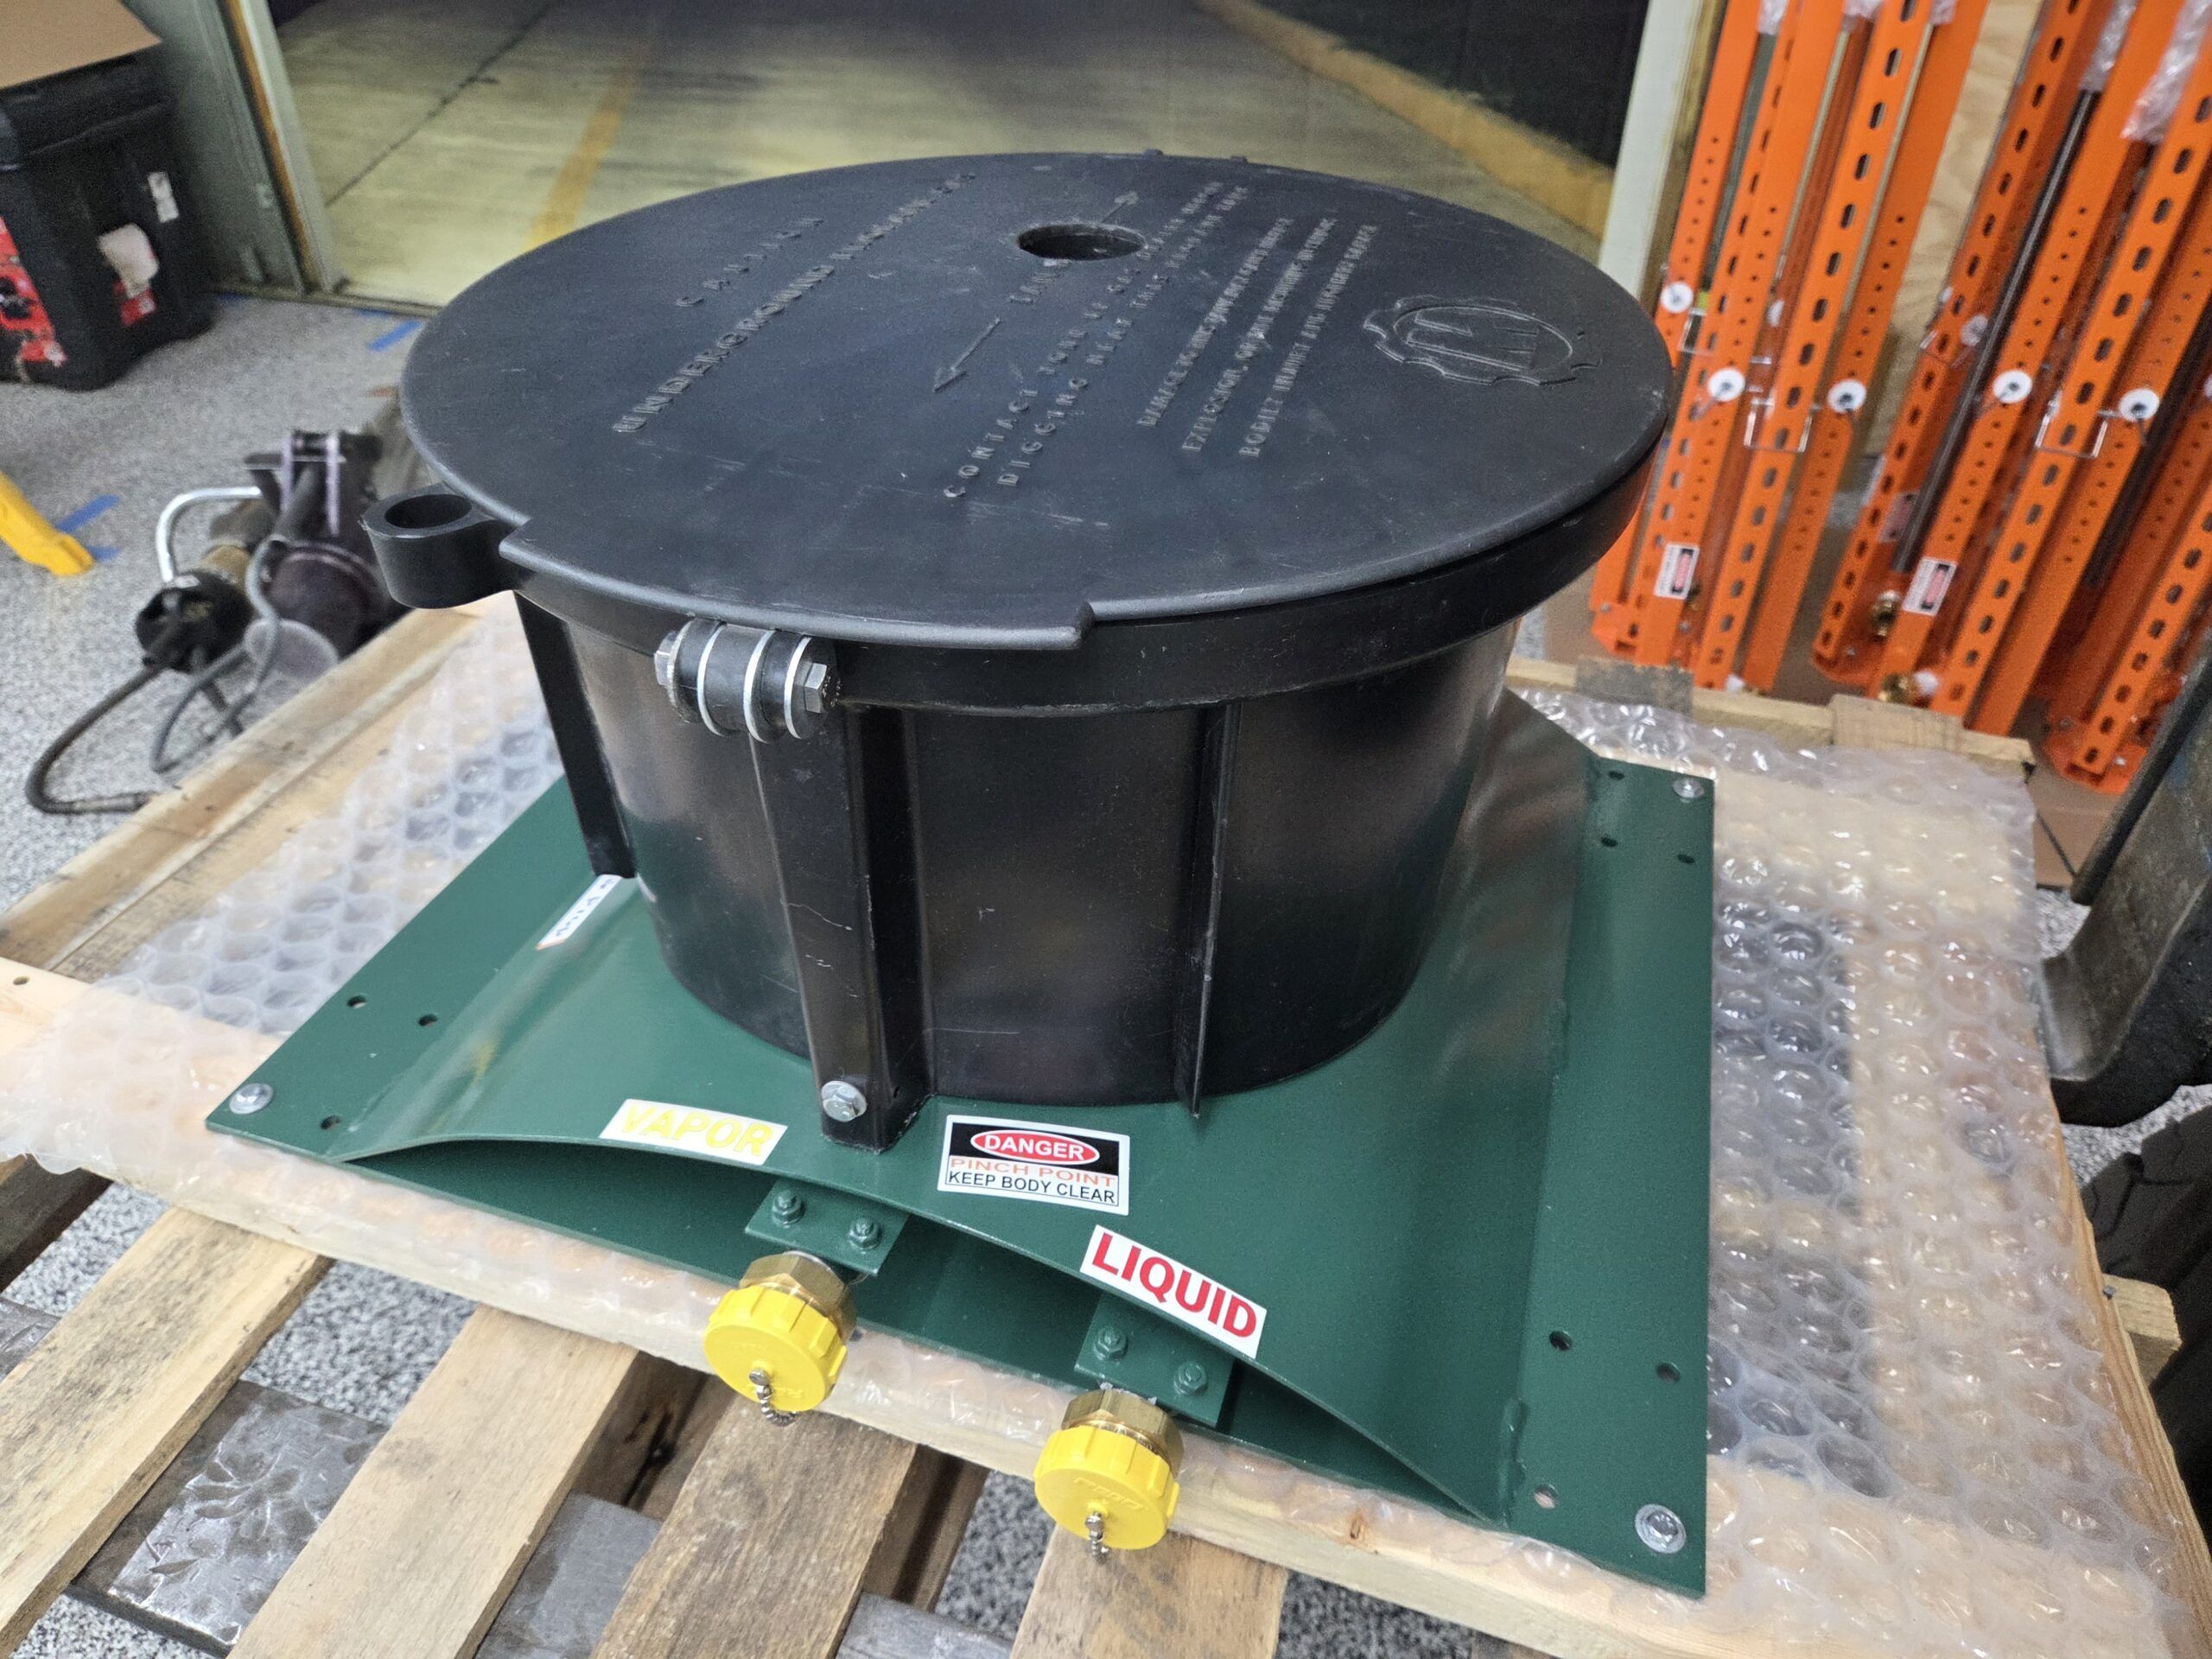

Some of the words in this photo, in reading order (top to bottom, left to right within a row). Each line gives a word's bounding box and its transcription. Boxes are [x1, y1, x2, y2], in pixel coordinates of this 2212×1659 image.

[613, 264, 835, 432] UNDERGROUND
[944, 389, 1038, 498] CONTACT
[997, 377, 1089, 486] DIGGING
[621, 1104, 773, 1156] VAPOR
[984, 1135, 1085, 1161] DANGER
[948, 1171, 996, 1187] KEEP
[1001, 1177, 1052, 1193] BODY
[1056, 1183, 1116, 1205] CLEAR
[950, 1159, 1029, 1176] PINCH
[1039, 1167, 1116, 1188] POINT
[1091, 1232, 1257, 1338] LIQUID
